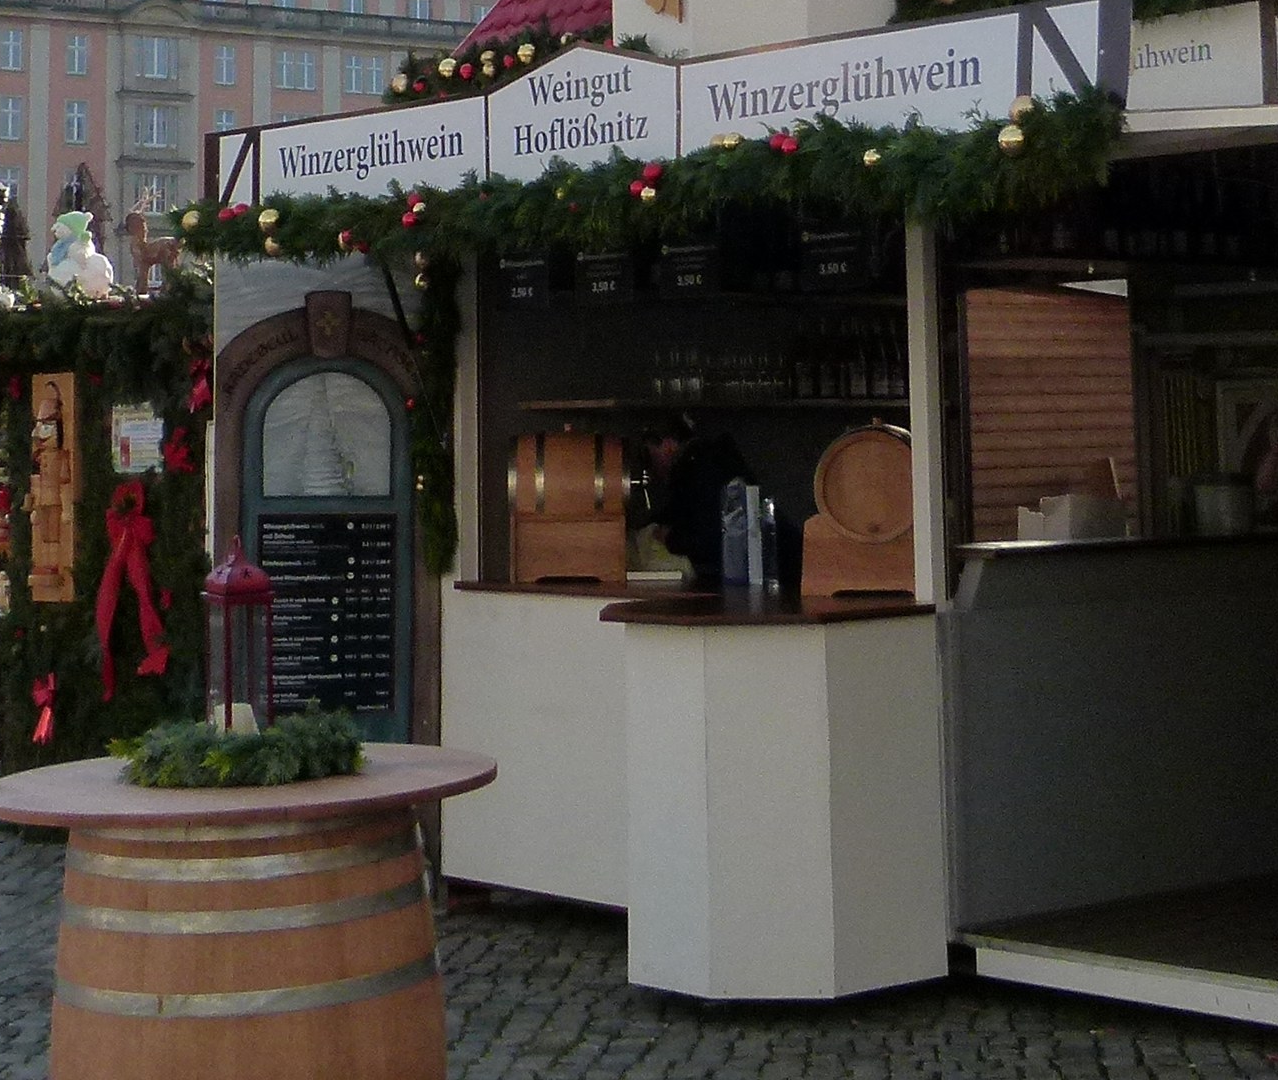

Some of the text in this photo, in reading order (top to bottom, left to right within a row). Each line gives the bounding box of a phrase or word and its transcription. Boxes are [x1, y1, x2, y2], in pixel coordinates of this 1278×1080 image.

[528, 61, 633, 108] Weingut
[706, 48, 982, 123] Winzerglühwein
[278, 123, 465, 181] Winzerglühwein
[513, 110, 649, 158] Hoflößnitz
